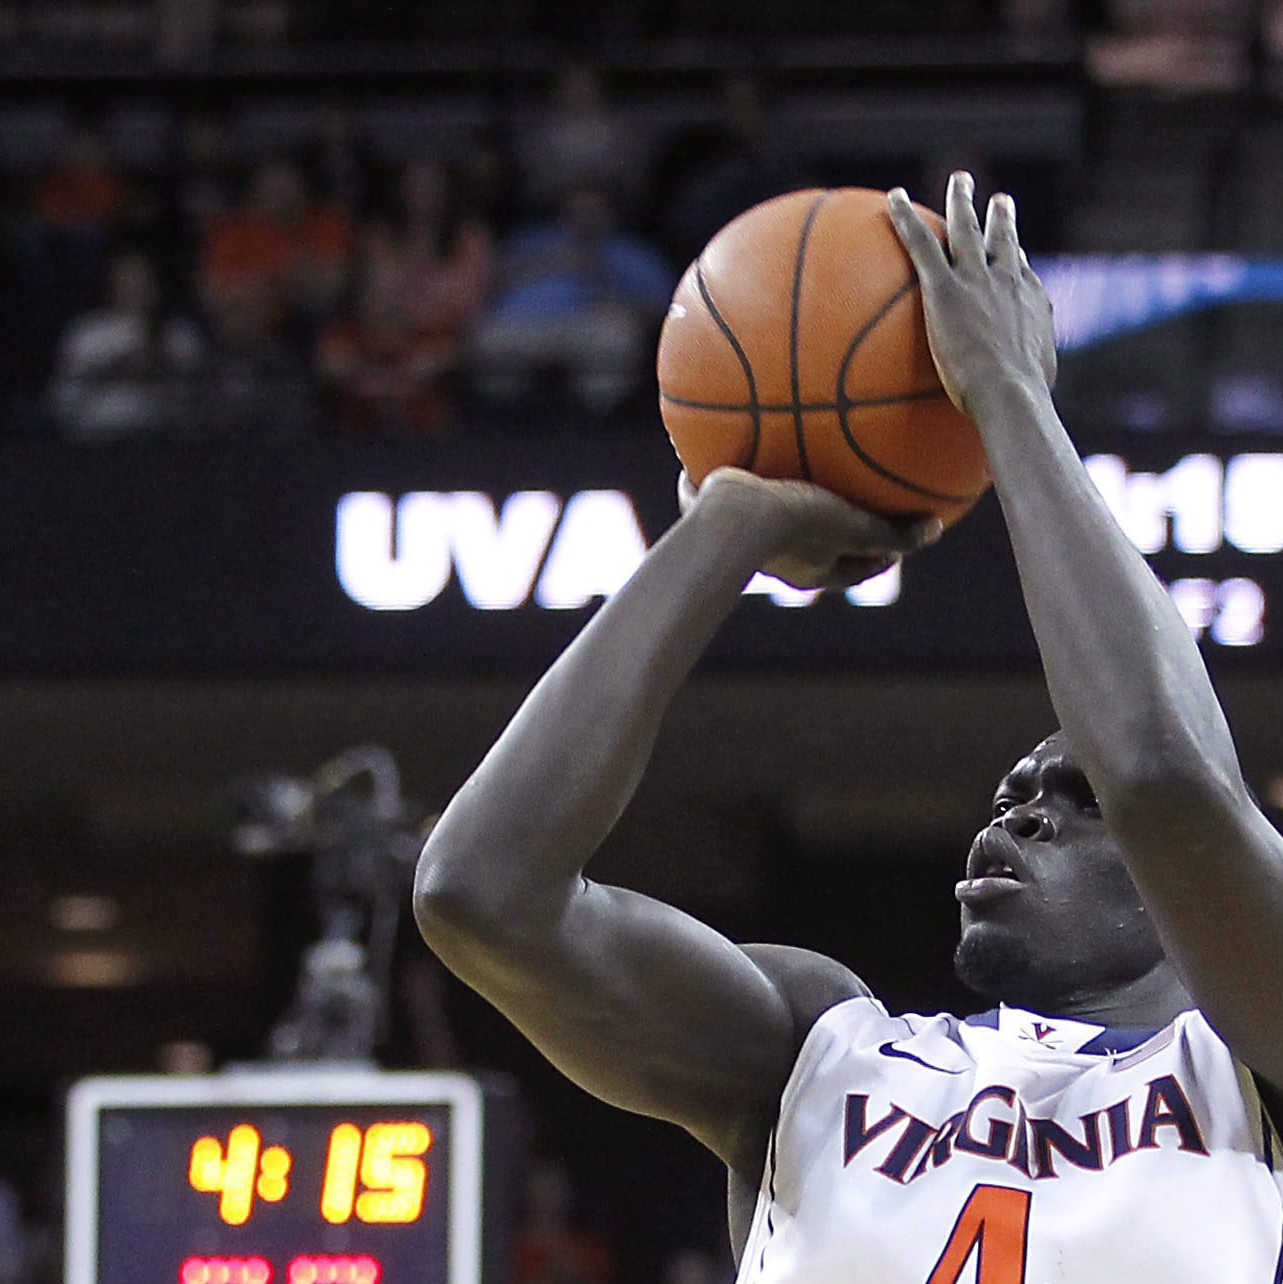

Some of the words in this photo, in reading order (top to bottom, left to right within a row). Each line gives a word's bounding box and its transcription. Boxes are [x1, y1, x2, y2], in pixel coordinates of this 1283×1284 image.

[335, 489, 649, 611] UVA
[188, 1120, 433, 1226] 4:15
[842, 1073, 1211, 1185] VIRGINIA
